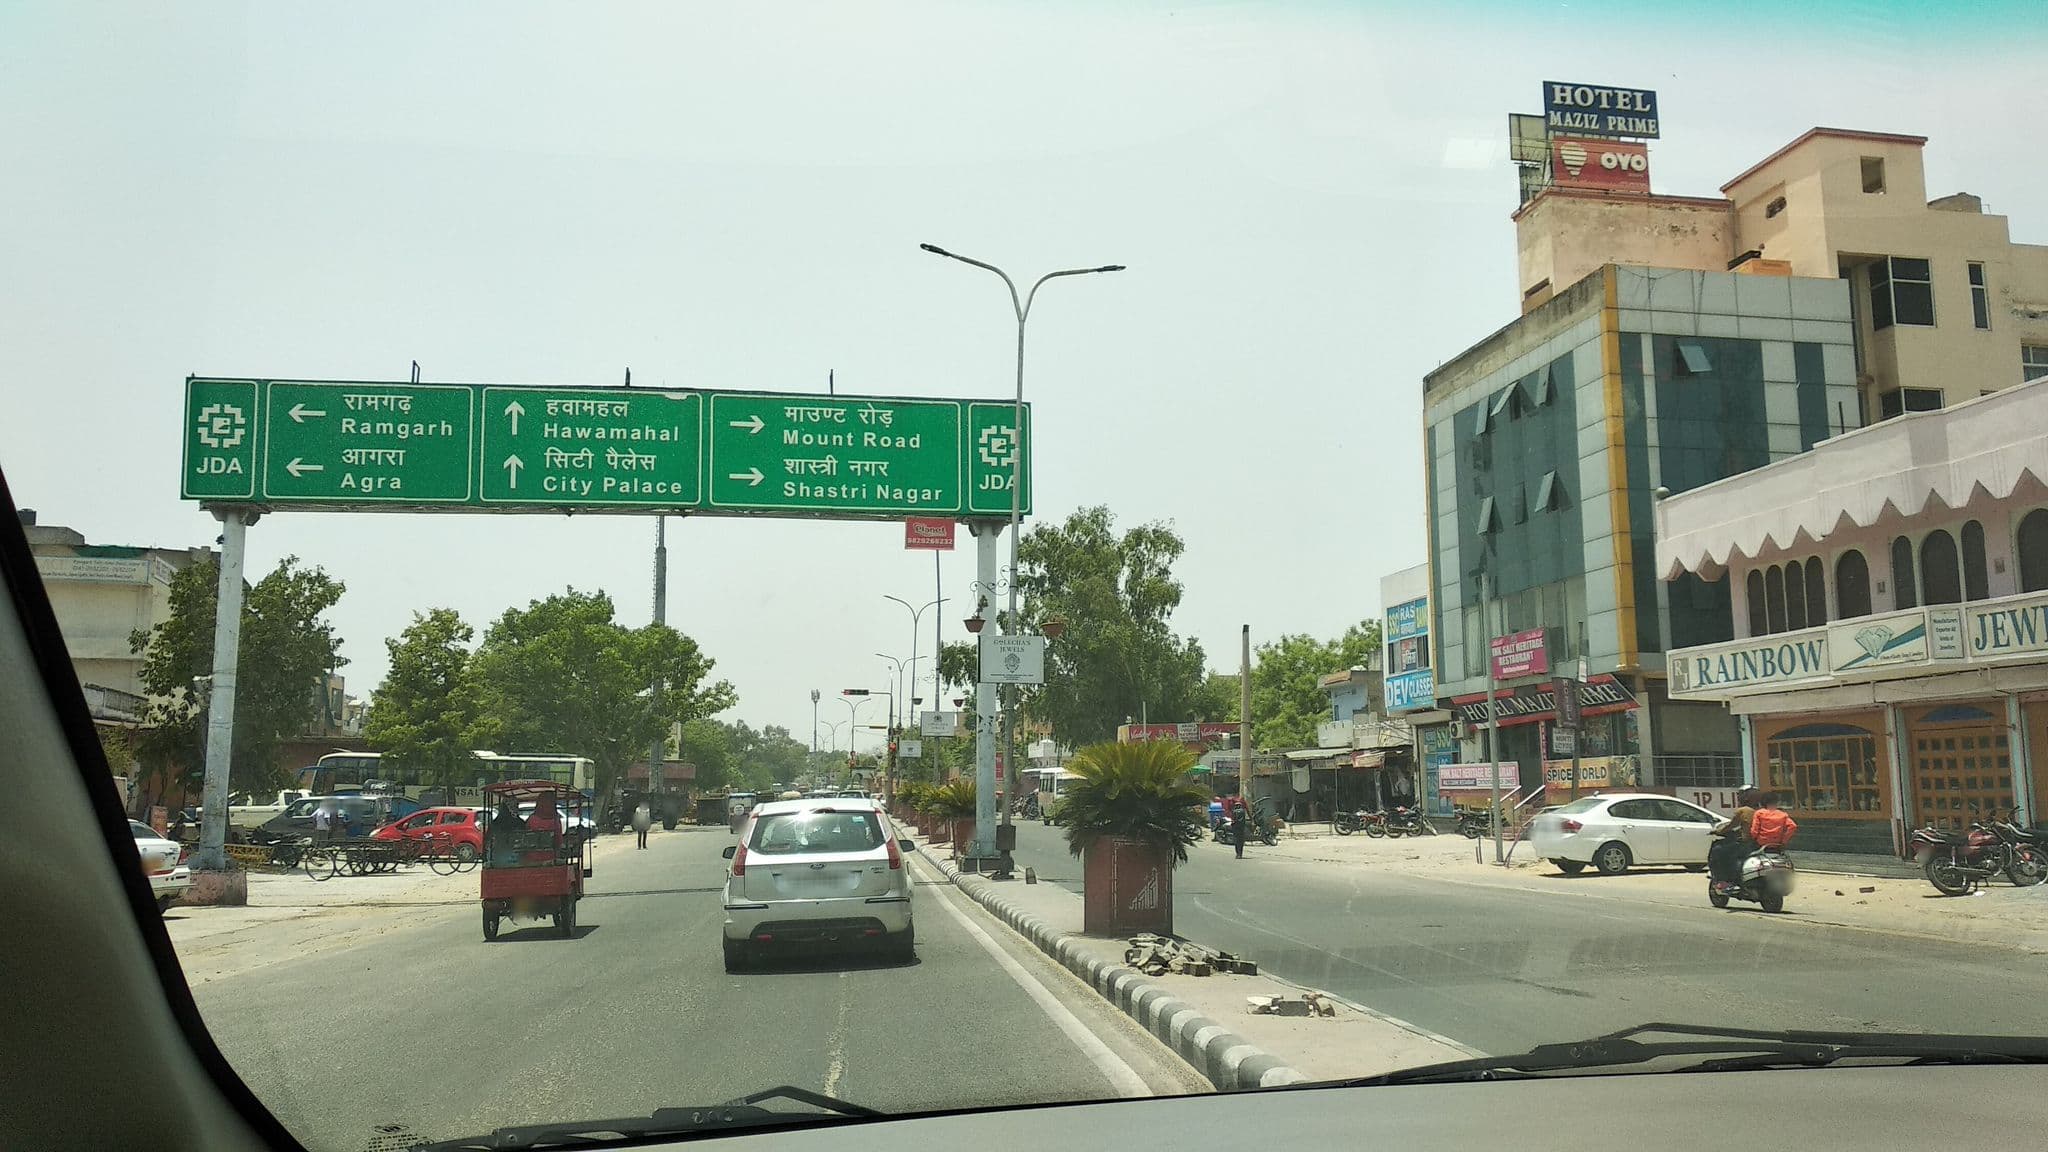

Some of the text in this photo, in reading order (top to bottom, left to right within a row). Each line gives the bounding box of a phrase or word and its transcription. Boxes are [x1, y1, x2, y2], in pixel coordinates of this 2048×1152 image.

[1551, 84, 1651, 112] HOTEL
[1549, 110, 1658, 134] MAZIZ PRIME
[1601, 152, 1647, 172] OYO
[342, 394, 414, 415] रामगढ़
[545, 399, 630, 418] हवामहल
[784, 405, 847, 424] माउण्ट
[341, 418, 453, 439] Ramgarh
[543, 423, 680, 442] Hawamahal
[783, 429, 921, 449] Mount Road
[196, 457, 244, 475] JDA
[341, 448, 406, 466] आगरा
[544, 446, 657, 471] सिटी पैलेस
[783, 454, 890, 477] शास्त्री नगर
[340, 473, 402, 493] Agra
[543, 476, 683, 496] City Palace
[783, 481, 943, 503] Shastri Nagar
[1693, 639, 1825, 688] RAINBOW
[1386, 677, 1409, 707] DEV
[1508, 692, 1557, 713] MAZI
[1547, 766, 1608, 781] SPICE ORLD
